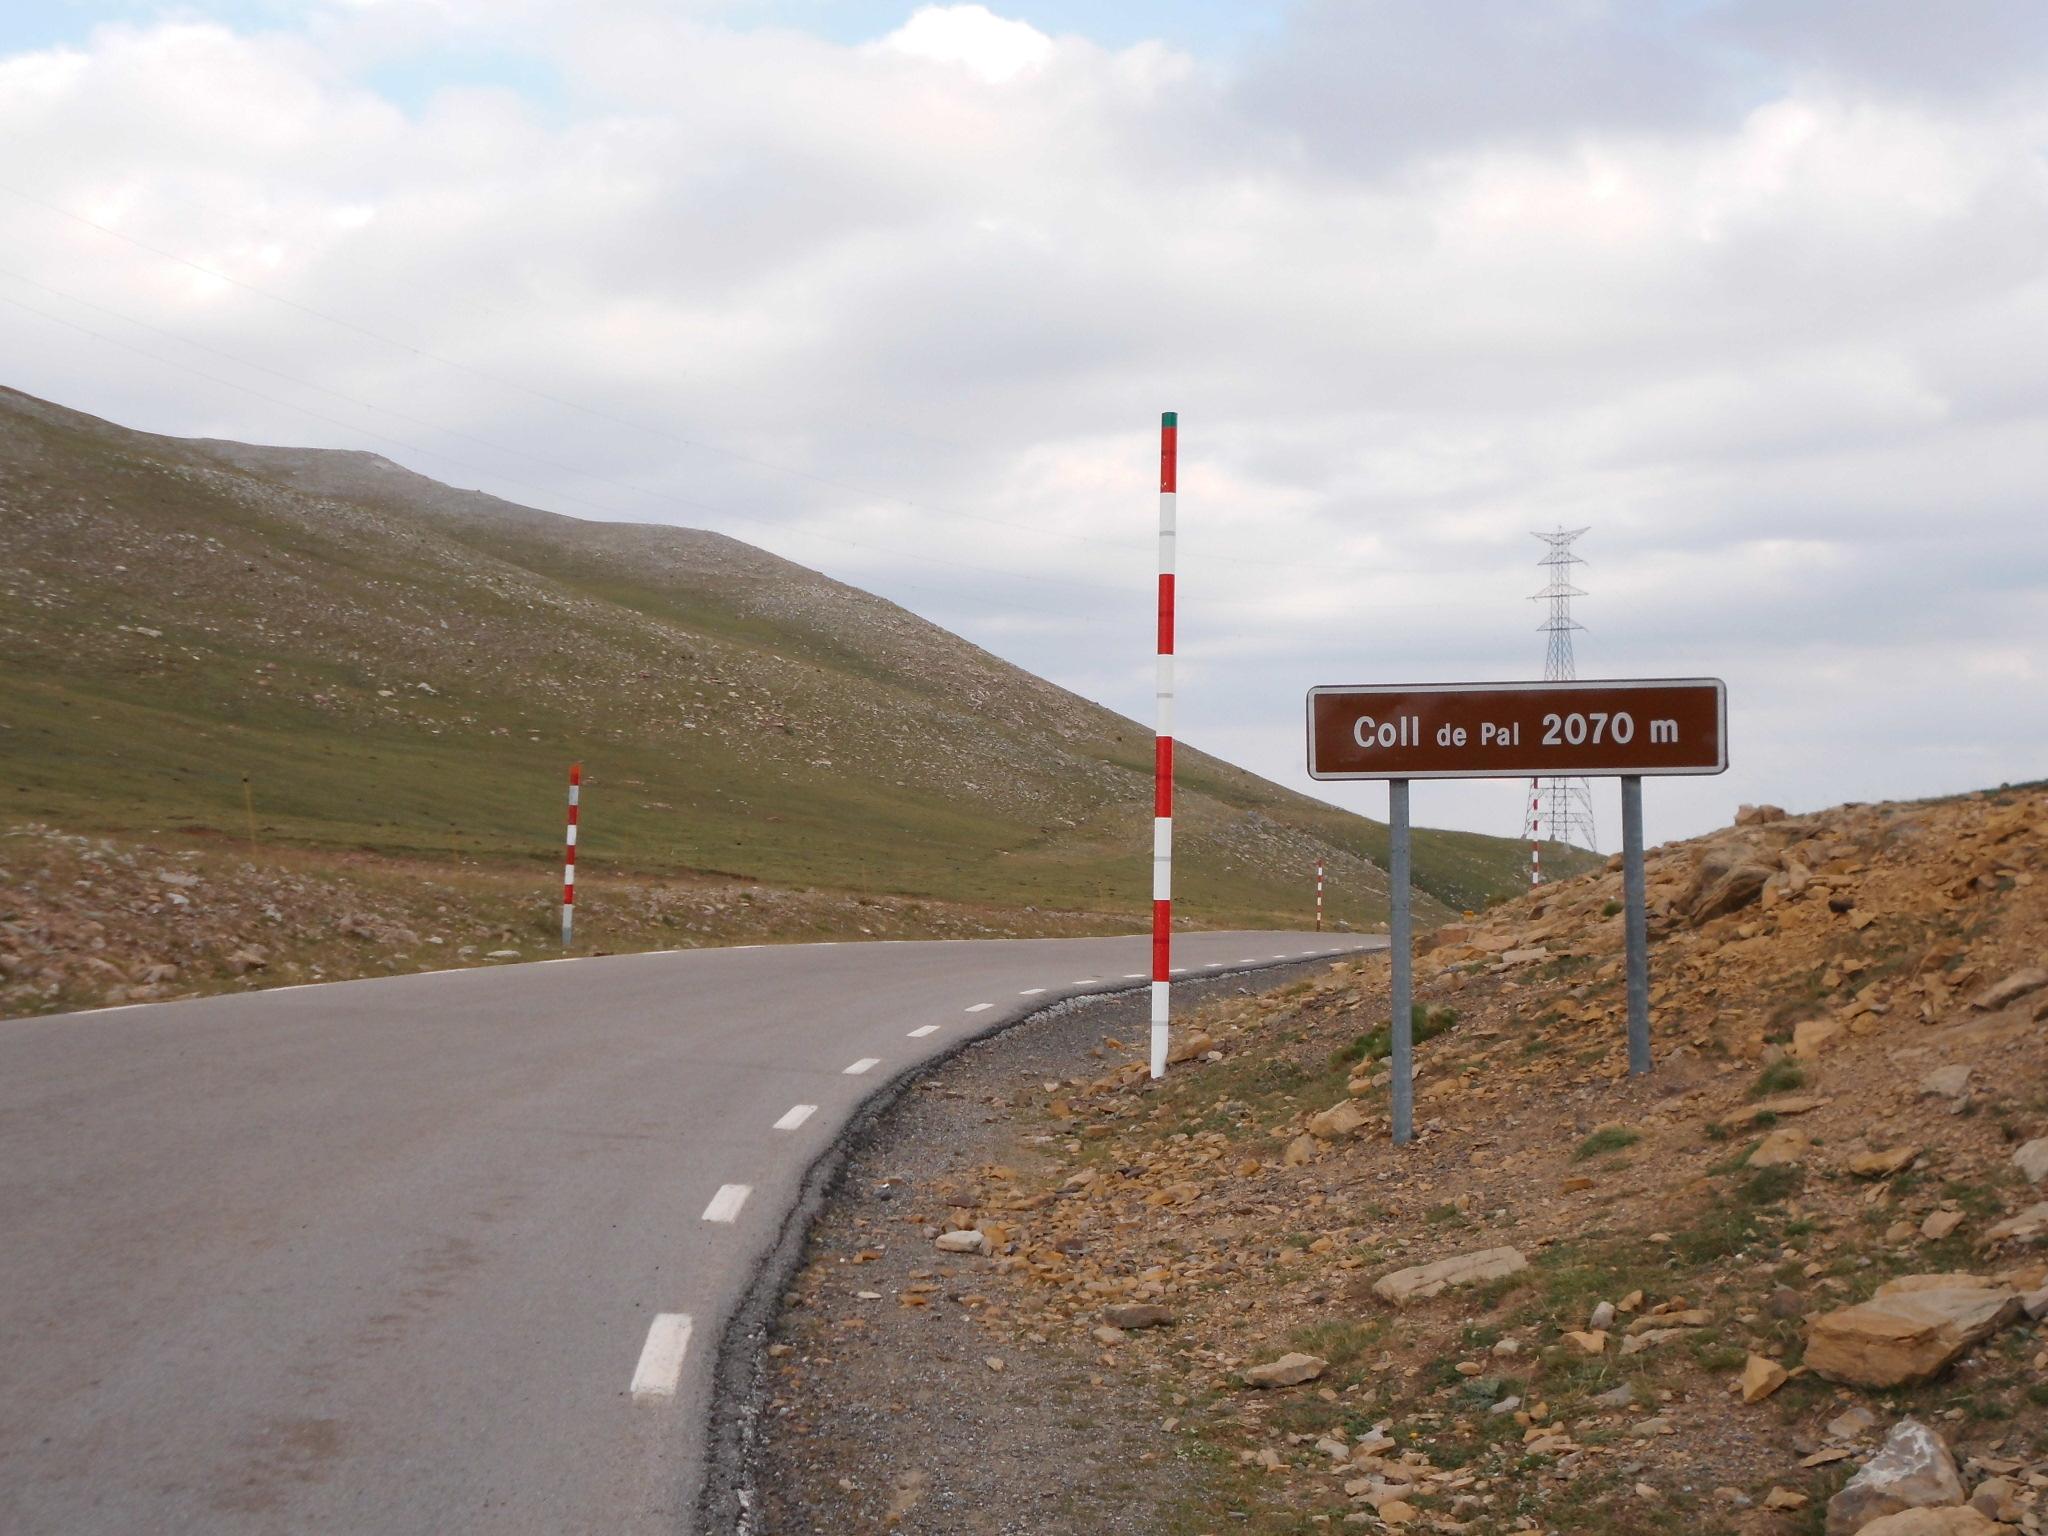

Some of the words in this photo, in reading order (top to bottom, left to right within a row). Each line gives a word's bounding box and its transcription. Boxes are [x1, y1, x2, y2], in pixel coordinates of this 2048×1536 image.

[1353, 715, 1419, 748] Coll
[1436, 723, 1467, 747] de
[1481, 722, 1520, 746] Pal
[1542, 712, 1634, 745] 2070
[1650, 719, 1678, 743] m
